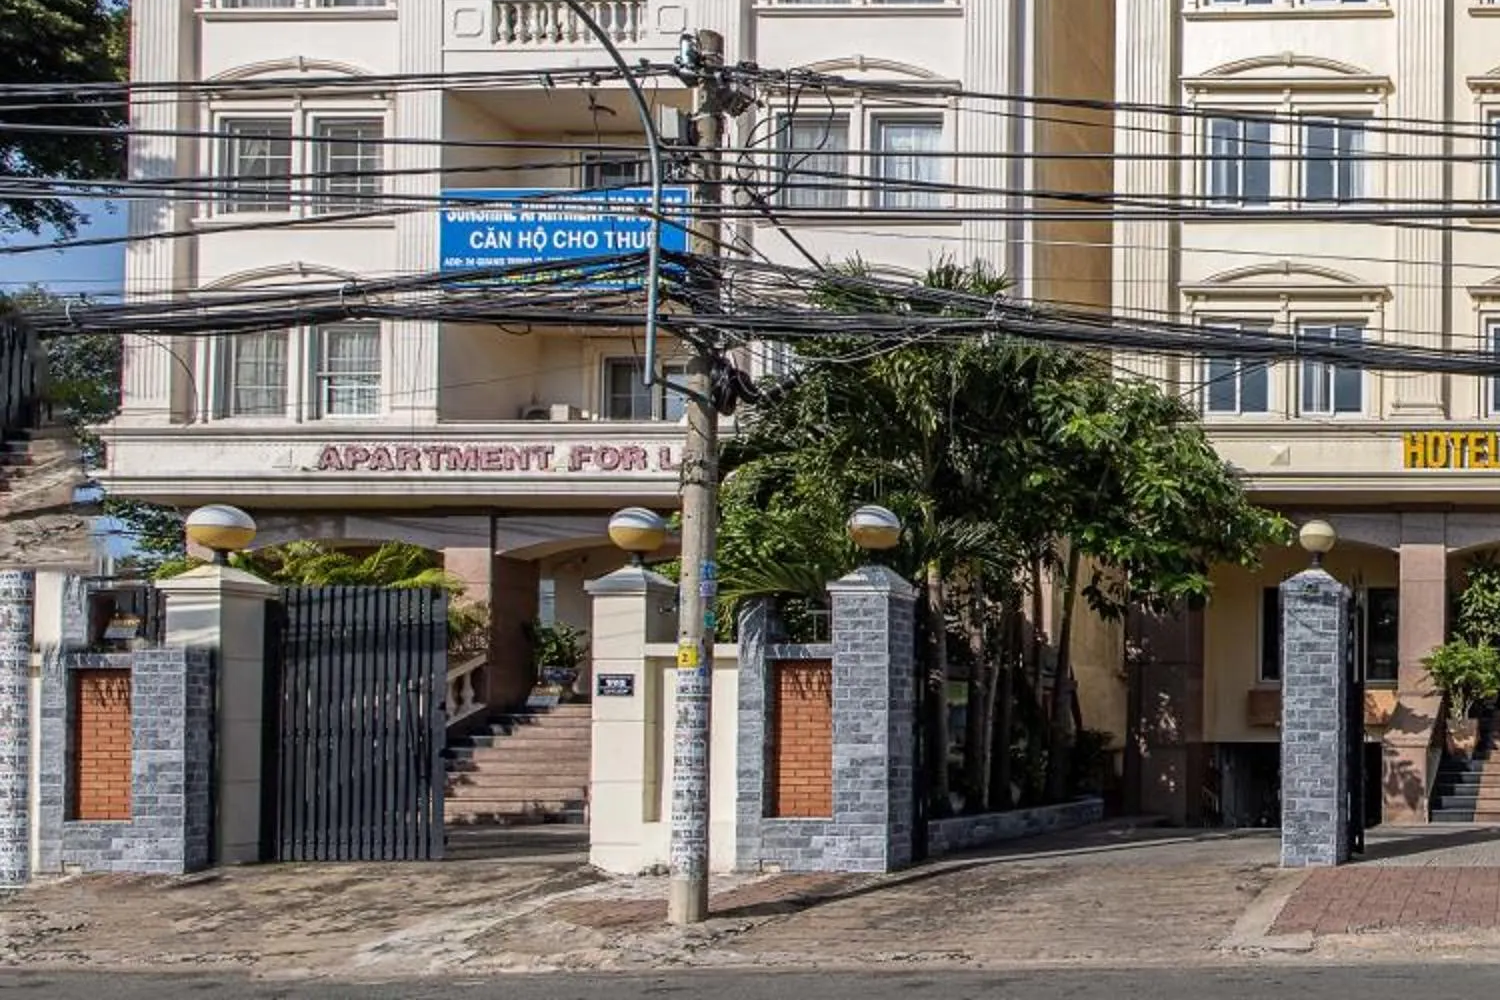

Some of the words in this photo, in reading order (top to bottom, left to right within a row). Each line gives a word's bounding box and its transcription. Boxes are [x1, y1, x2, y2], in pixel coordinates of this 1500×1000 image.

[469, 226, 513, 249] CĂN
[518, 225, 548, 252] HỘ
[553, 230, 599, 249] CHO
[318, 444, 555, 471] APARTMENT
[568, 446, 648, 471] FOR
